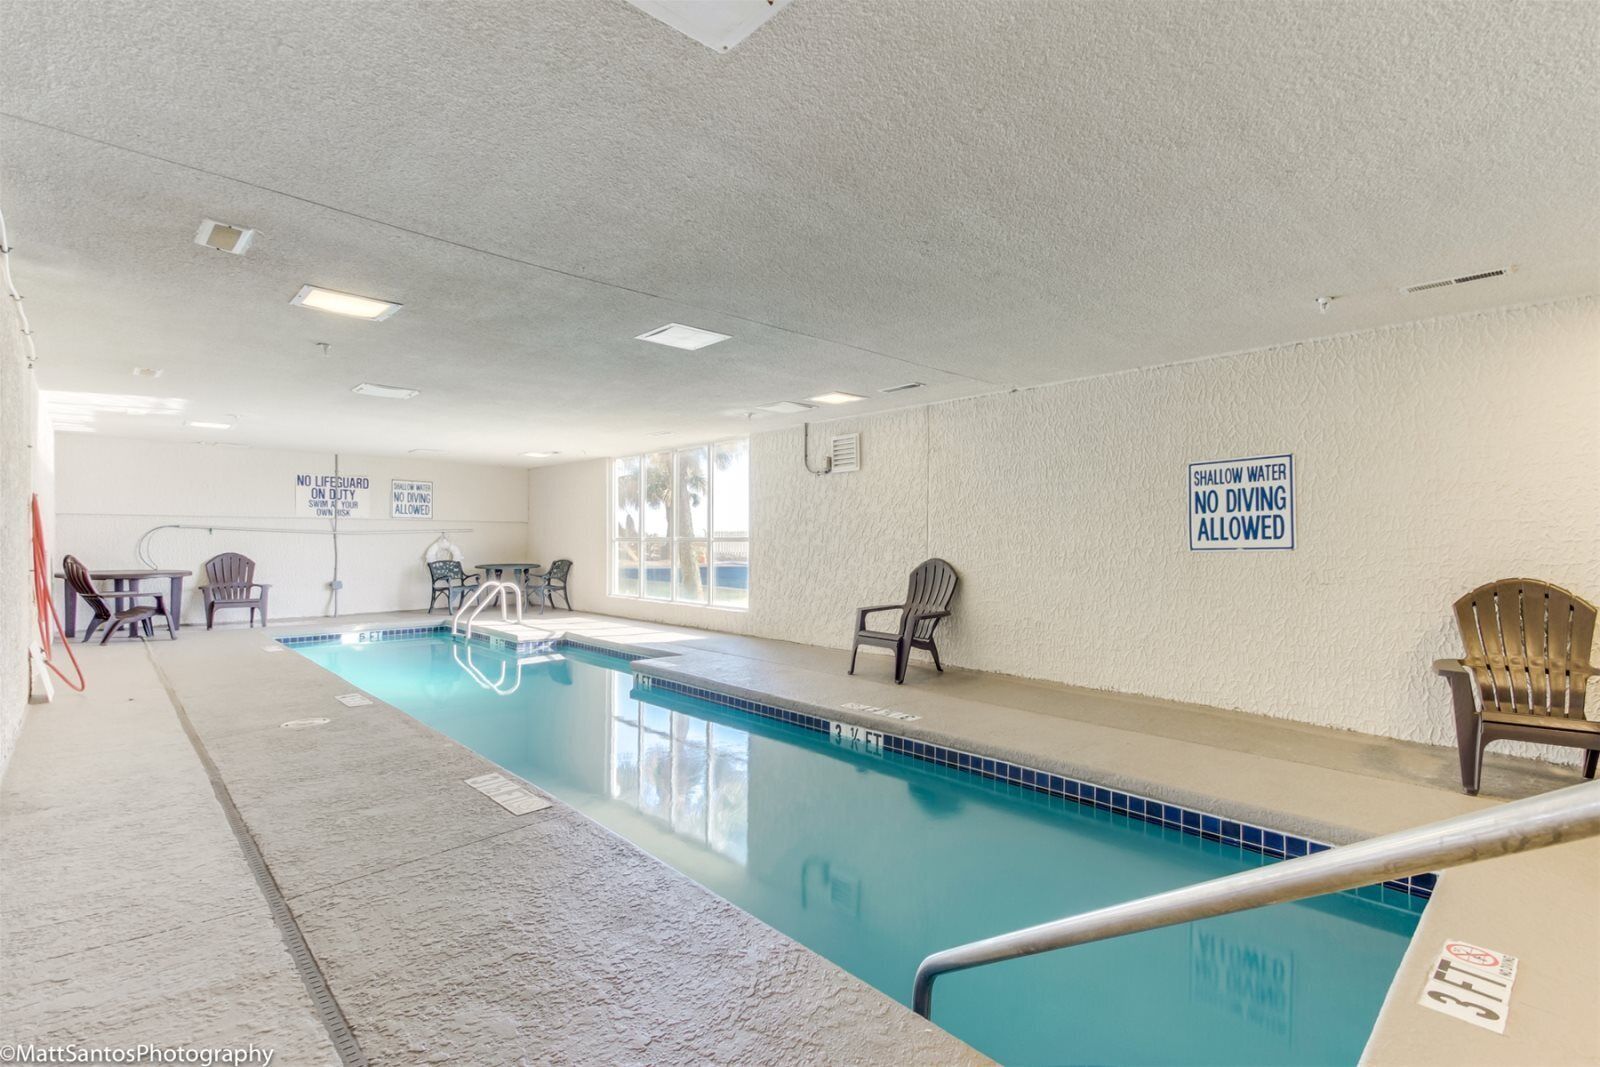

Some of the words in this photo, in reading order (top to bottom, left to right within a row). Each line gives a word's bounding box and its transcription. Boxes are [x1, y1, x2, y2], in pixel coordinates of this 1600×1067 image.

[297, 474, 312, 487] NO
[315, 475, 370, 490] LIFEGUARD
[1194, 466, 1243, 486] SHALLOW
[1247, 463, 1287, 482] WATER
[311, 487, 326, 500] ON
[329, 488, 356, 501] DUTY
[394, 491, 405, 503] NO
[407, 492, 431, 504] DIVING
[1195, 489, 1219, 514] NO
[1226, 485, 1287, 513] DIVING
[308, 499, 329, 508] SWIM
[341, 500, 359, 509] YOUR
[395, 503, 431, 516] ALLOWED
[316, 508, 333, 517] OWN
[1197, 515, 1285, 541] ALLOWED
[865, 731, 882, 746] FT
[1433, 958, 1507, 1003] FT
[1427, 990, 1500, 1020] 3
